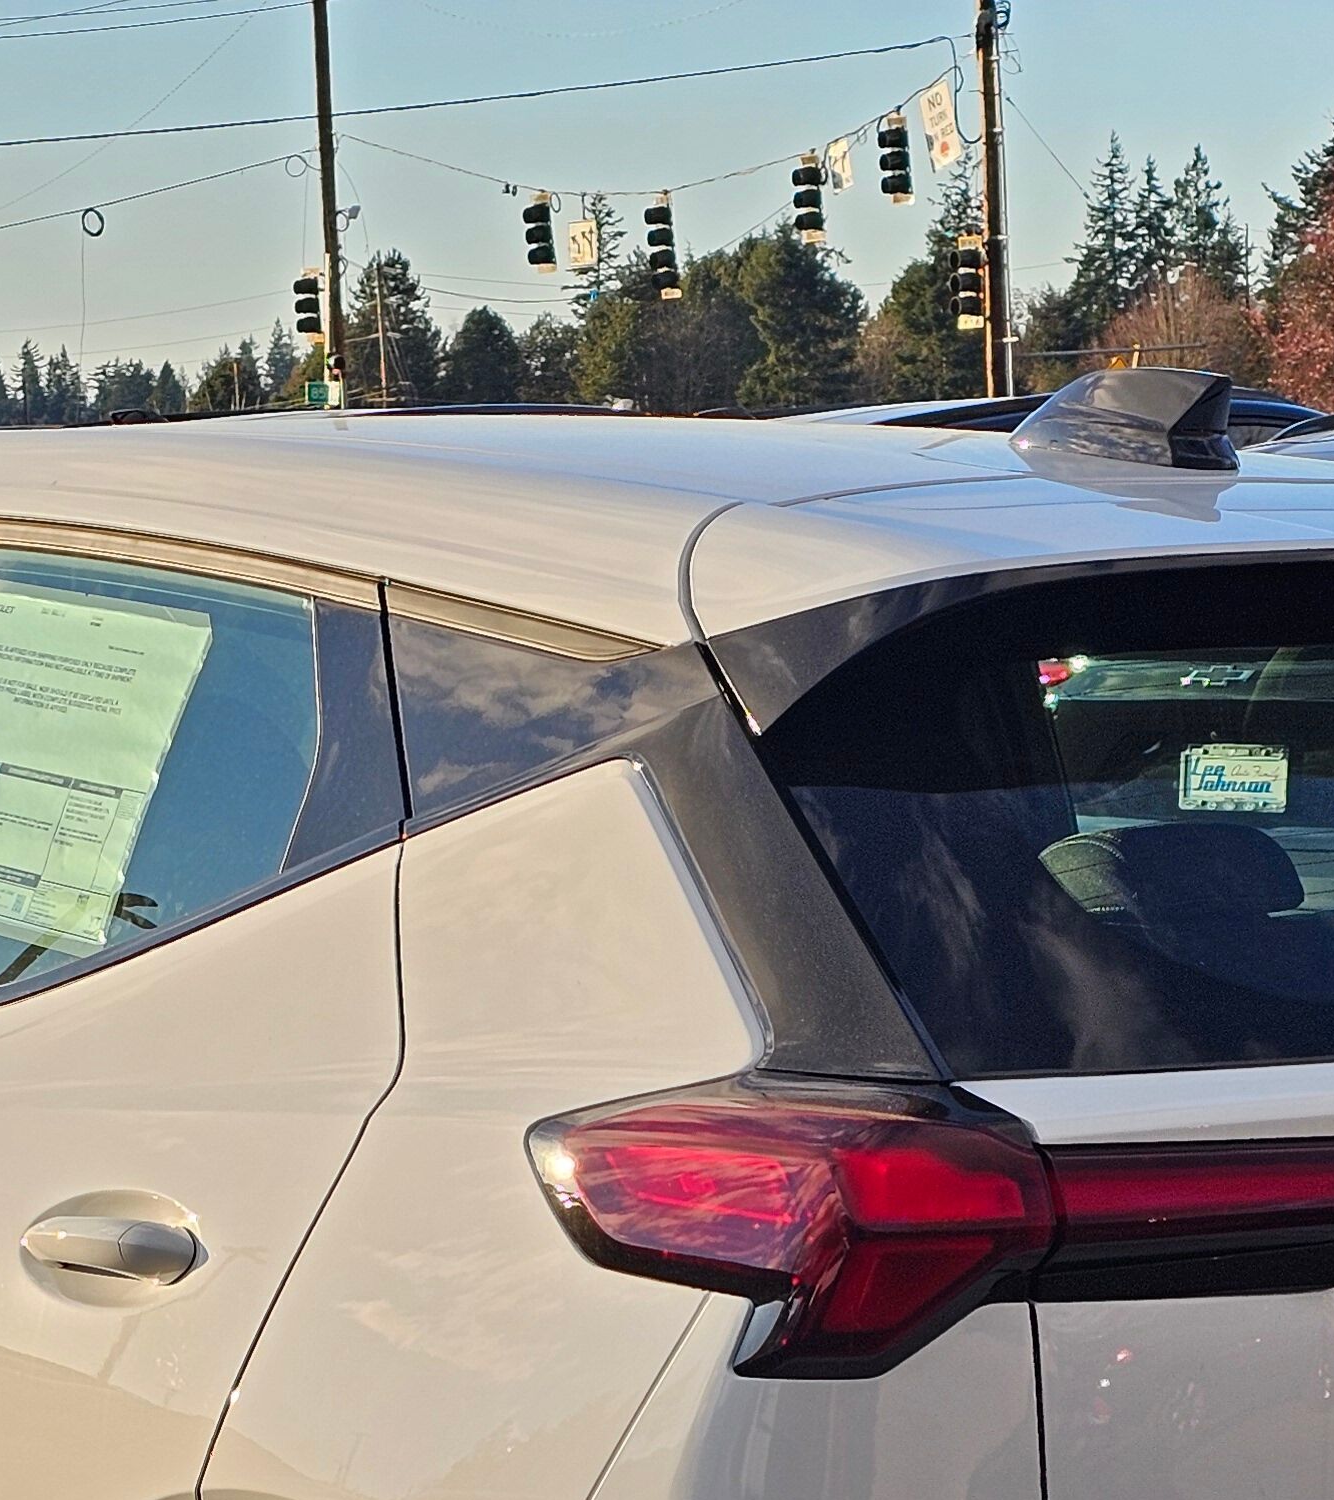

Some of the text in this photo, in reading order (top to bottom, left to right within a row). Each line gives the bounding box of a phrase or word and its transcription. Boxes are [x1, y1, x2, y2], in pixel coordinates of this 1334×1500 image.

[927, 92, 943, 111] NO
[1191, 757, 1226, 775] Lee
[1193, 773, 1272, 793] Johnson
